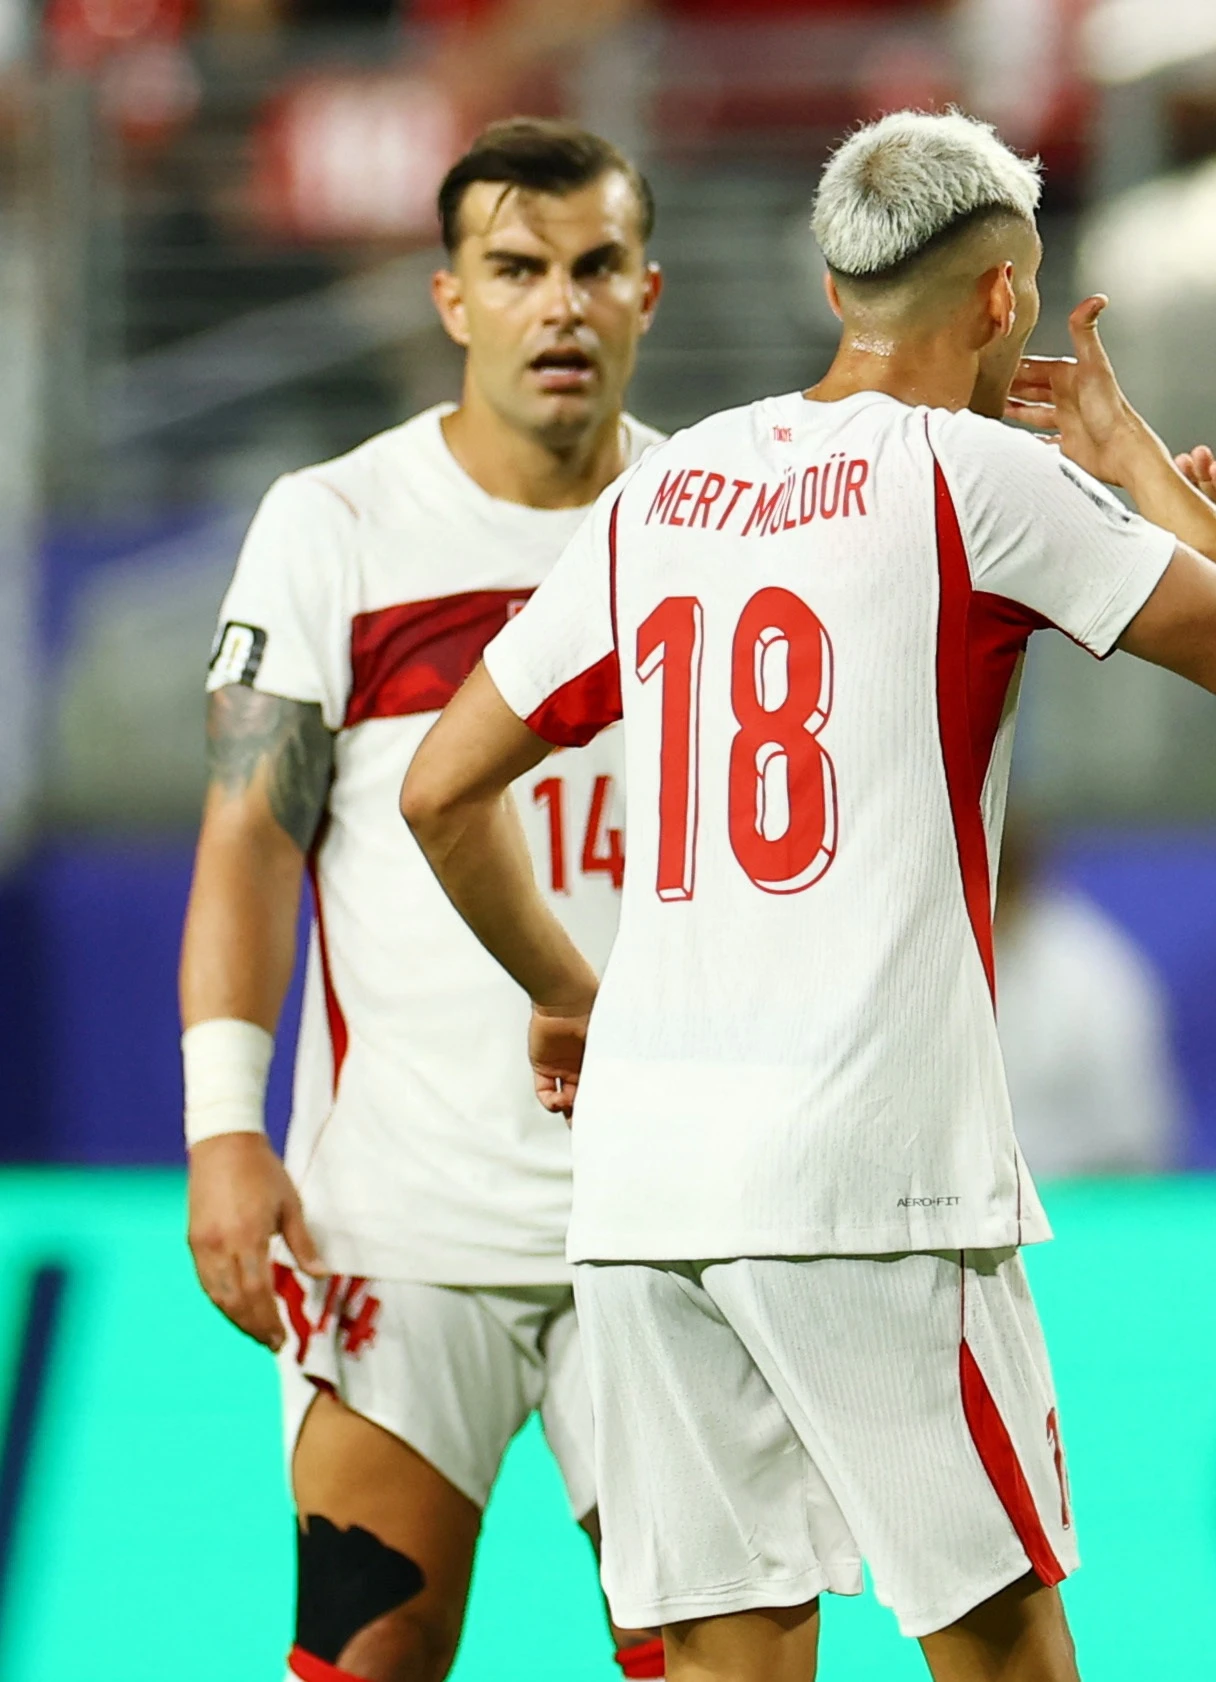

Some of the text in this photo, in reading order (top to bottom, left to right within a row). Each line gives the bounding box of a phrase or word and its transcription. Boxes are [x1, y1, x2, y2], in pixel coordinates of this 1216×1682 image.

[645, 452, 868, 537] MERT MÜLDÜR
[636, 586, 838, 902] 18
[533, 775, 624, 892] 14
